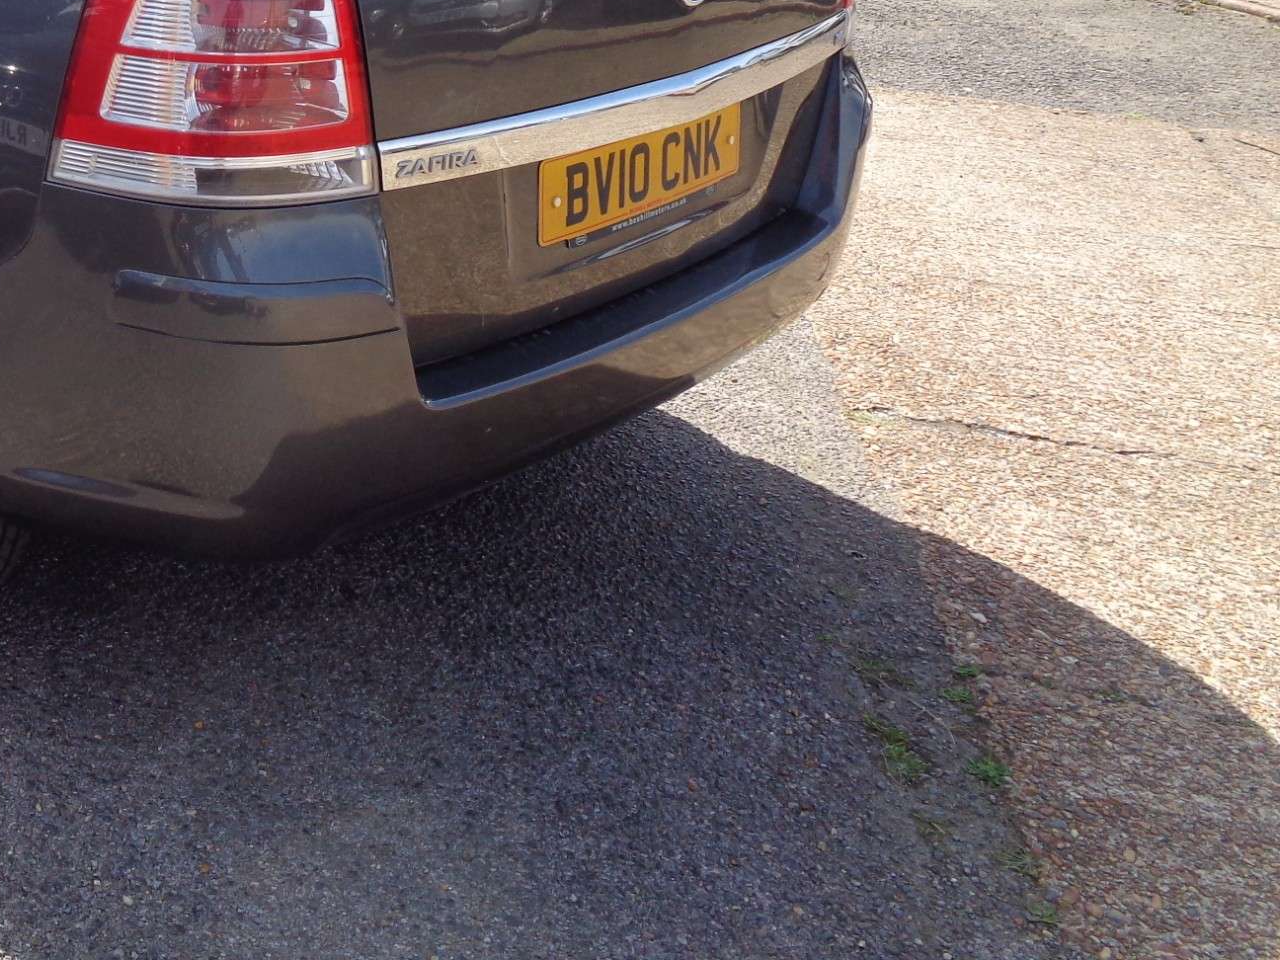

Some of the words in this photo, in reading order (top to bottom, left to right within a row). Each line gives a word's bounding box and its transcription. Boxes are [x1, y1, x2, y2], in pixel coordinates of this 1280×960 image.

[395, 148, 479, 178] ZAFIRA
[565, 141, 651, 228] BV10
[661, 113, 723, 192] CNK
